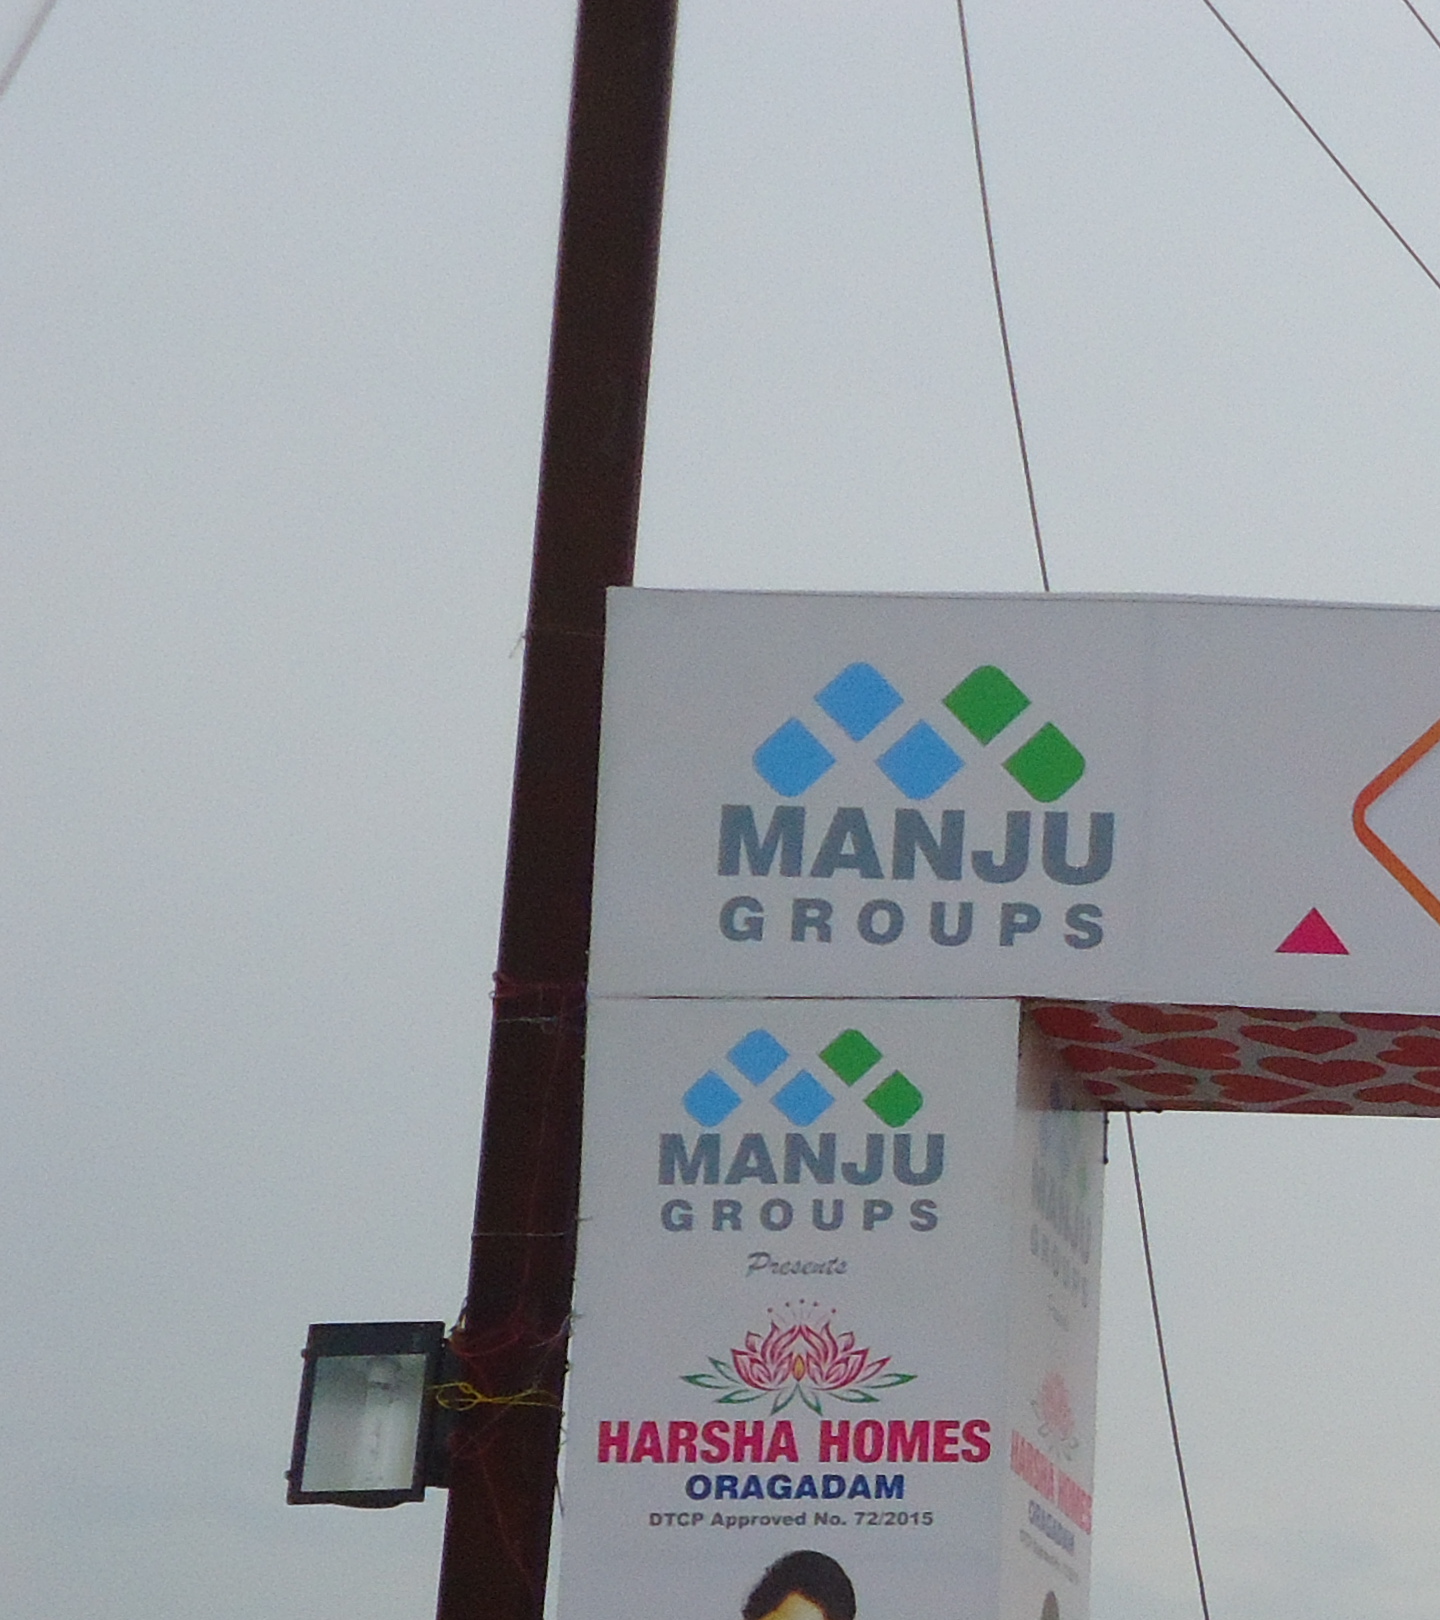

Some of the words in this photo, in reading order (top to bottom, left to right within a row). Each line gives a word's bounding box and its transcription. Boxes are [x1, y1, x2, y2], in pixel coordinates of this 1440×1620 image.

[718, 805, 1114, 885] MANJU
[719, 896, 1105, 949] GROUPS
[658, 1133, 945, 1185] MANJU
[661, 1198, 939, 1232] GROUPS
[746, 1252, 848, 1278] Presents
[597, 1420, 799, 1464] HARSHA
[818, 1419, 991, 1464] HOMES
[685, 1474, 906, 1500] ORAGADAM
[649, 1512, 703, 1526] DTCP
[711, 1512, 807, 1530] Approved
[814, 1512, 847, 1526] No.
[855, 1512, 933, 1527] 72/2015
